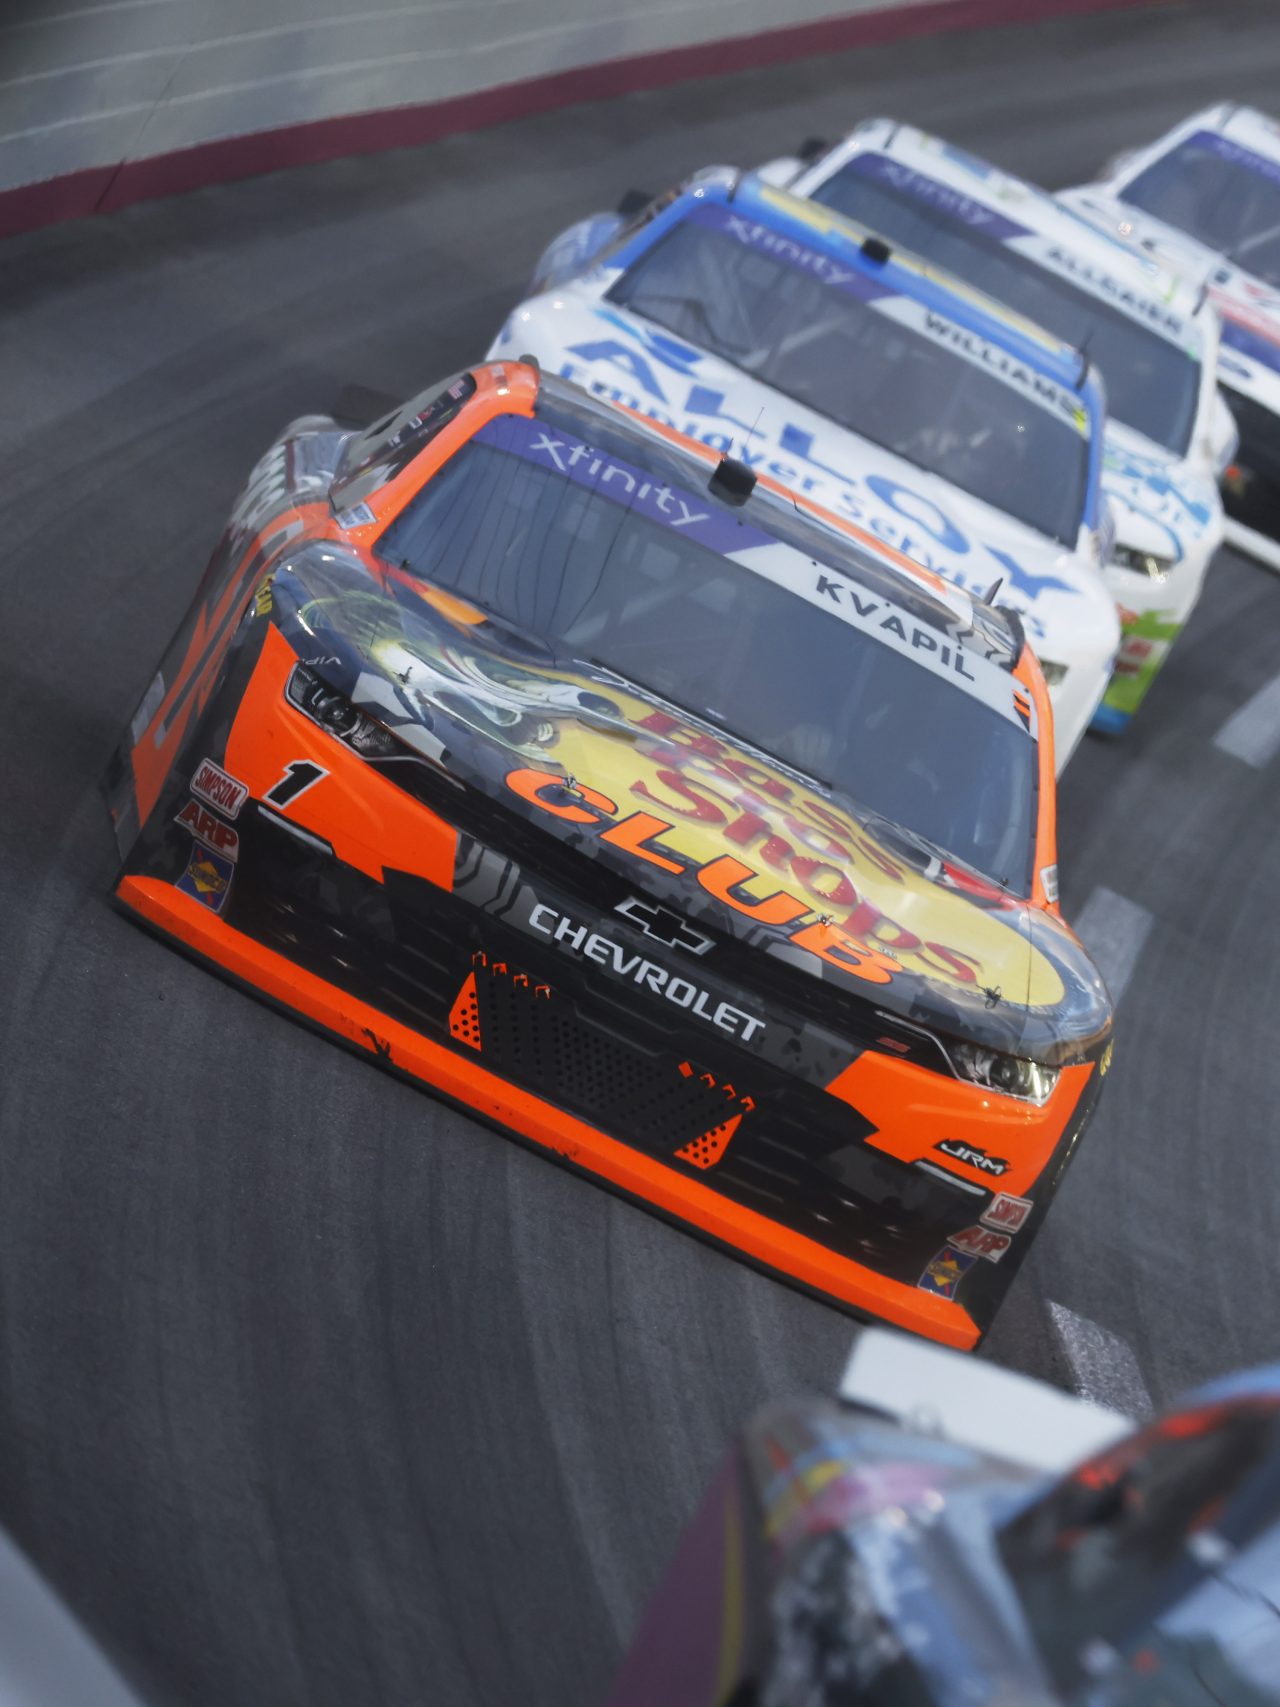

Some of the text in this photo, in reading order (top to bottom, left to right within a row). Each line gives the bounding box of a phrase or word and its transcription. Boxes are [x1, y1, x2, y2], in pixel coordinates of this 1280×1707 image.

[564, 340, 1080, 601] ALLOY
[816, 575, 975, 681] KVAPIL
[179, 803, 238, 850] ARP
[195, 763, 243, 816] SIMPSON
[262, 759, 331, 810] 1
[634, 709, 907, 885] Bass
[638, 738, 855, 866] Pro
[505, 767, 904, 985] CLUB
[630, 768, 984, 984] Shops
[528, 904, 767, 1042] CHEVROLET
[941, 1143, 1004, 1175] JRM
